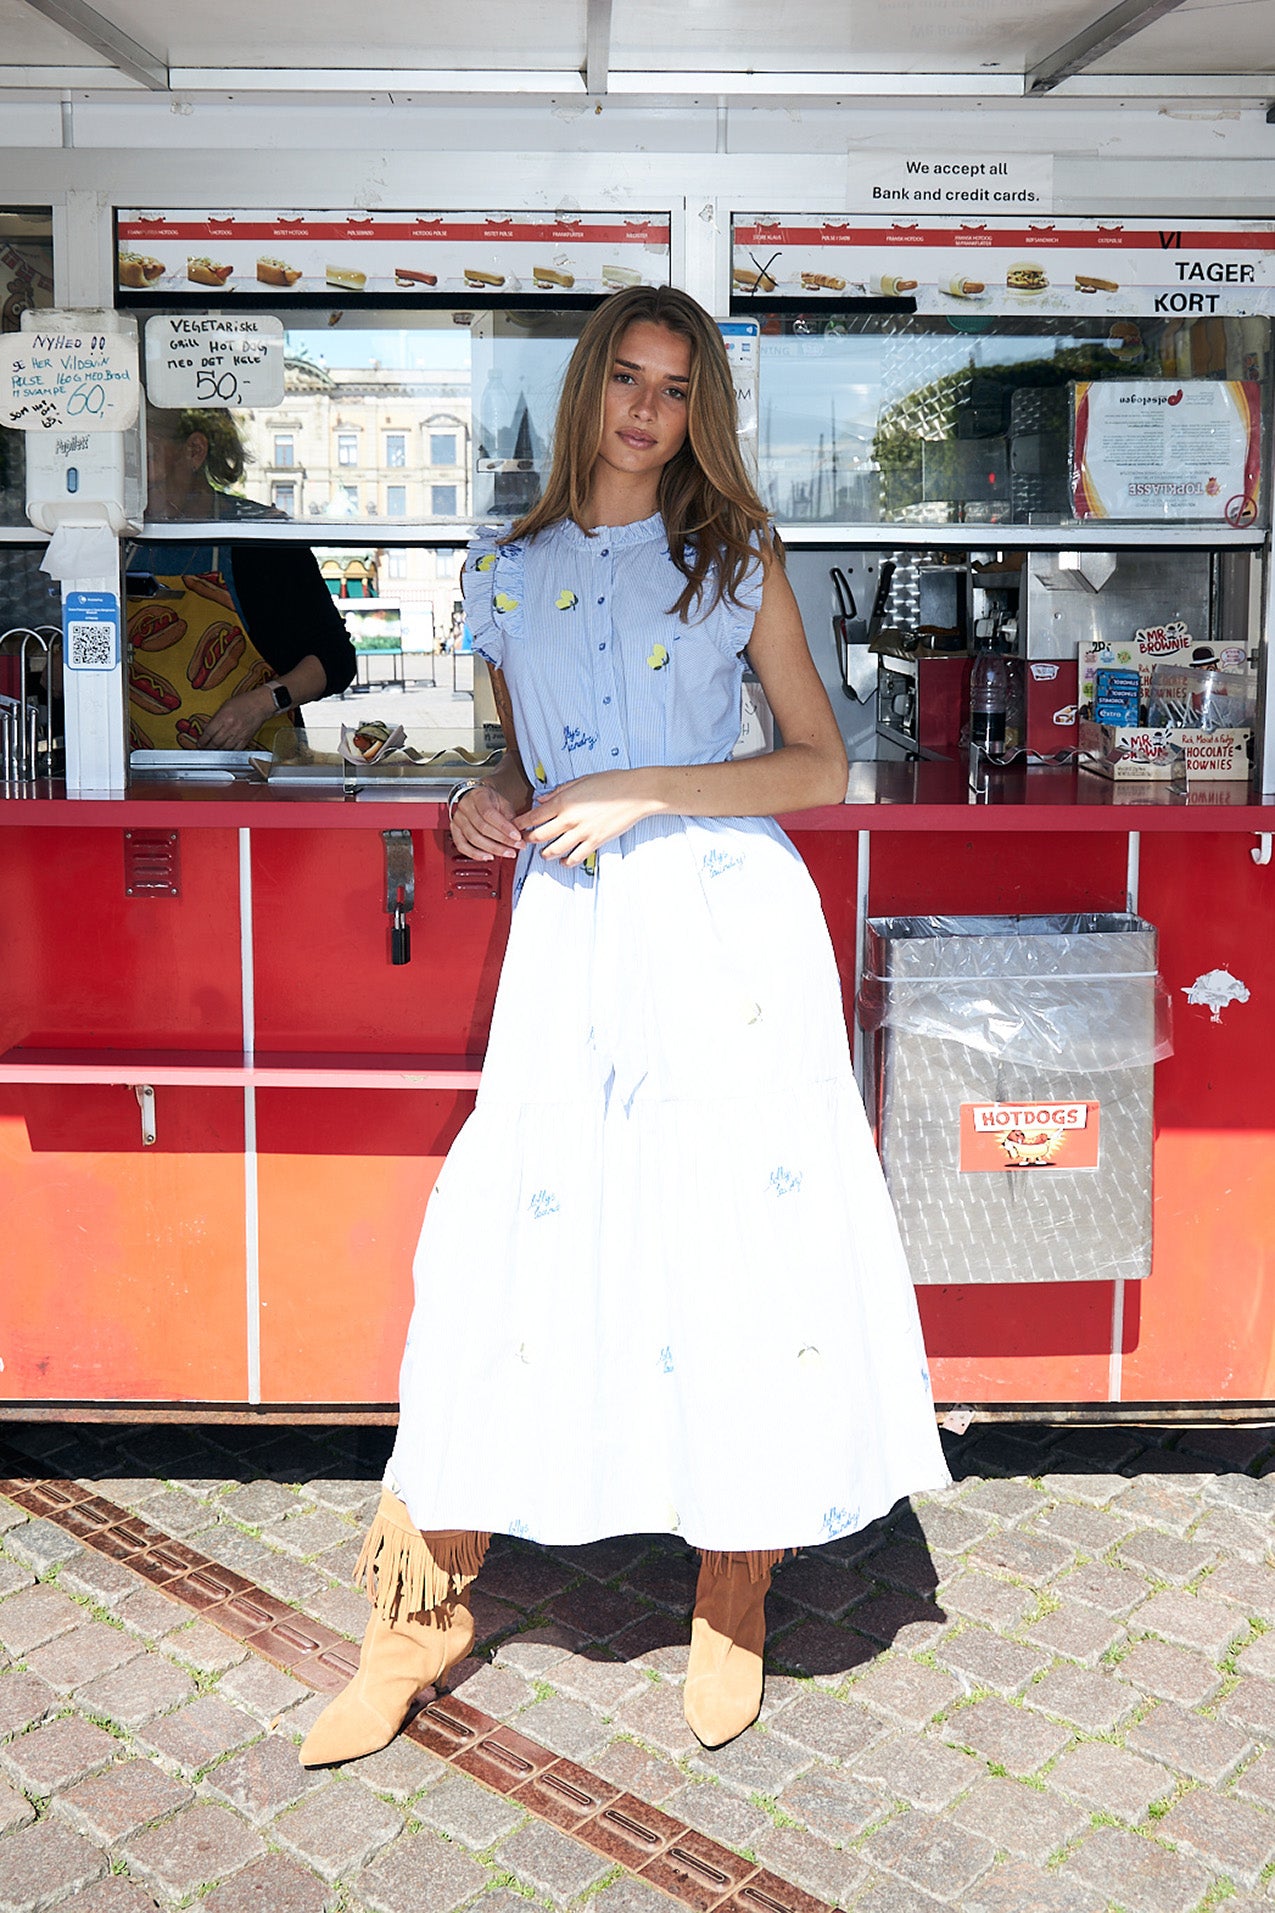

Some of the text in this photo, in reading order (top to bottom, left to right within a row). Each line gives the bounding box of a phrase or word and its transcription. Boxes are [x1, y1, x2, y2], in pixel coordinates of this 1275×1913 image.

[906, 161, 1008, 177] We accept all
[872, 187, 1040, 202] Bank and credit cards.
[1158, 231, 1182, 249] VI
[1175, 262, 1255, 282] TAGER
[1155, 293, 1220, 312] KORT
[32, 335, 82, 351] NYHED
[209, 341, 235, 353] HOT
[31, 358, 53, 369] HER
[1128, 483, 1204, 496] TOPKLASSE
[1139, 634, 1190, 653] BROWNIE
[1185, 746, 1234, 758] HOCOLATE
[1187, 759, 1232, 770] ROWNIES
[982, 1109, 1078, 1126] HOTDOGS
